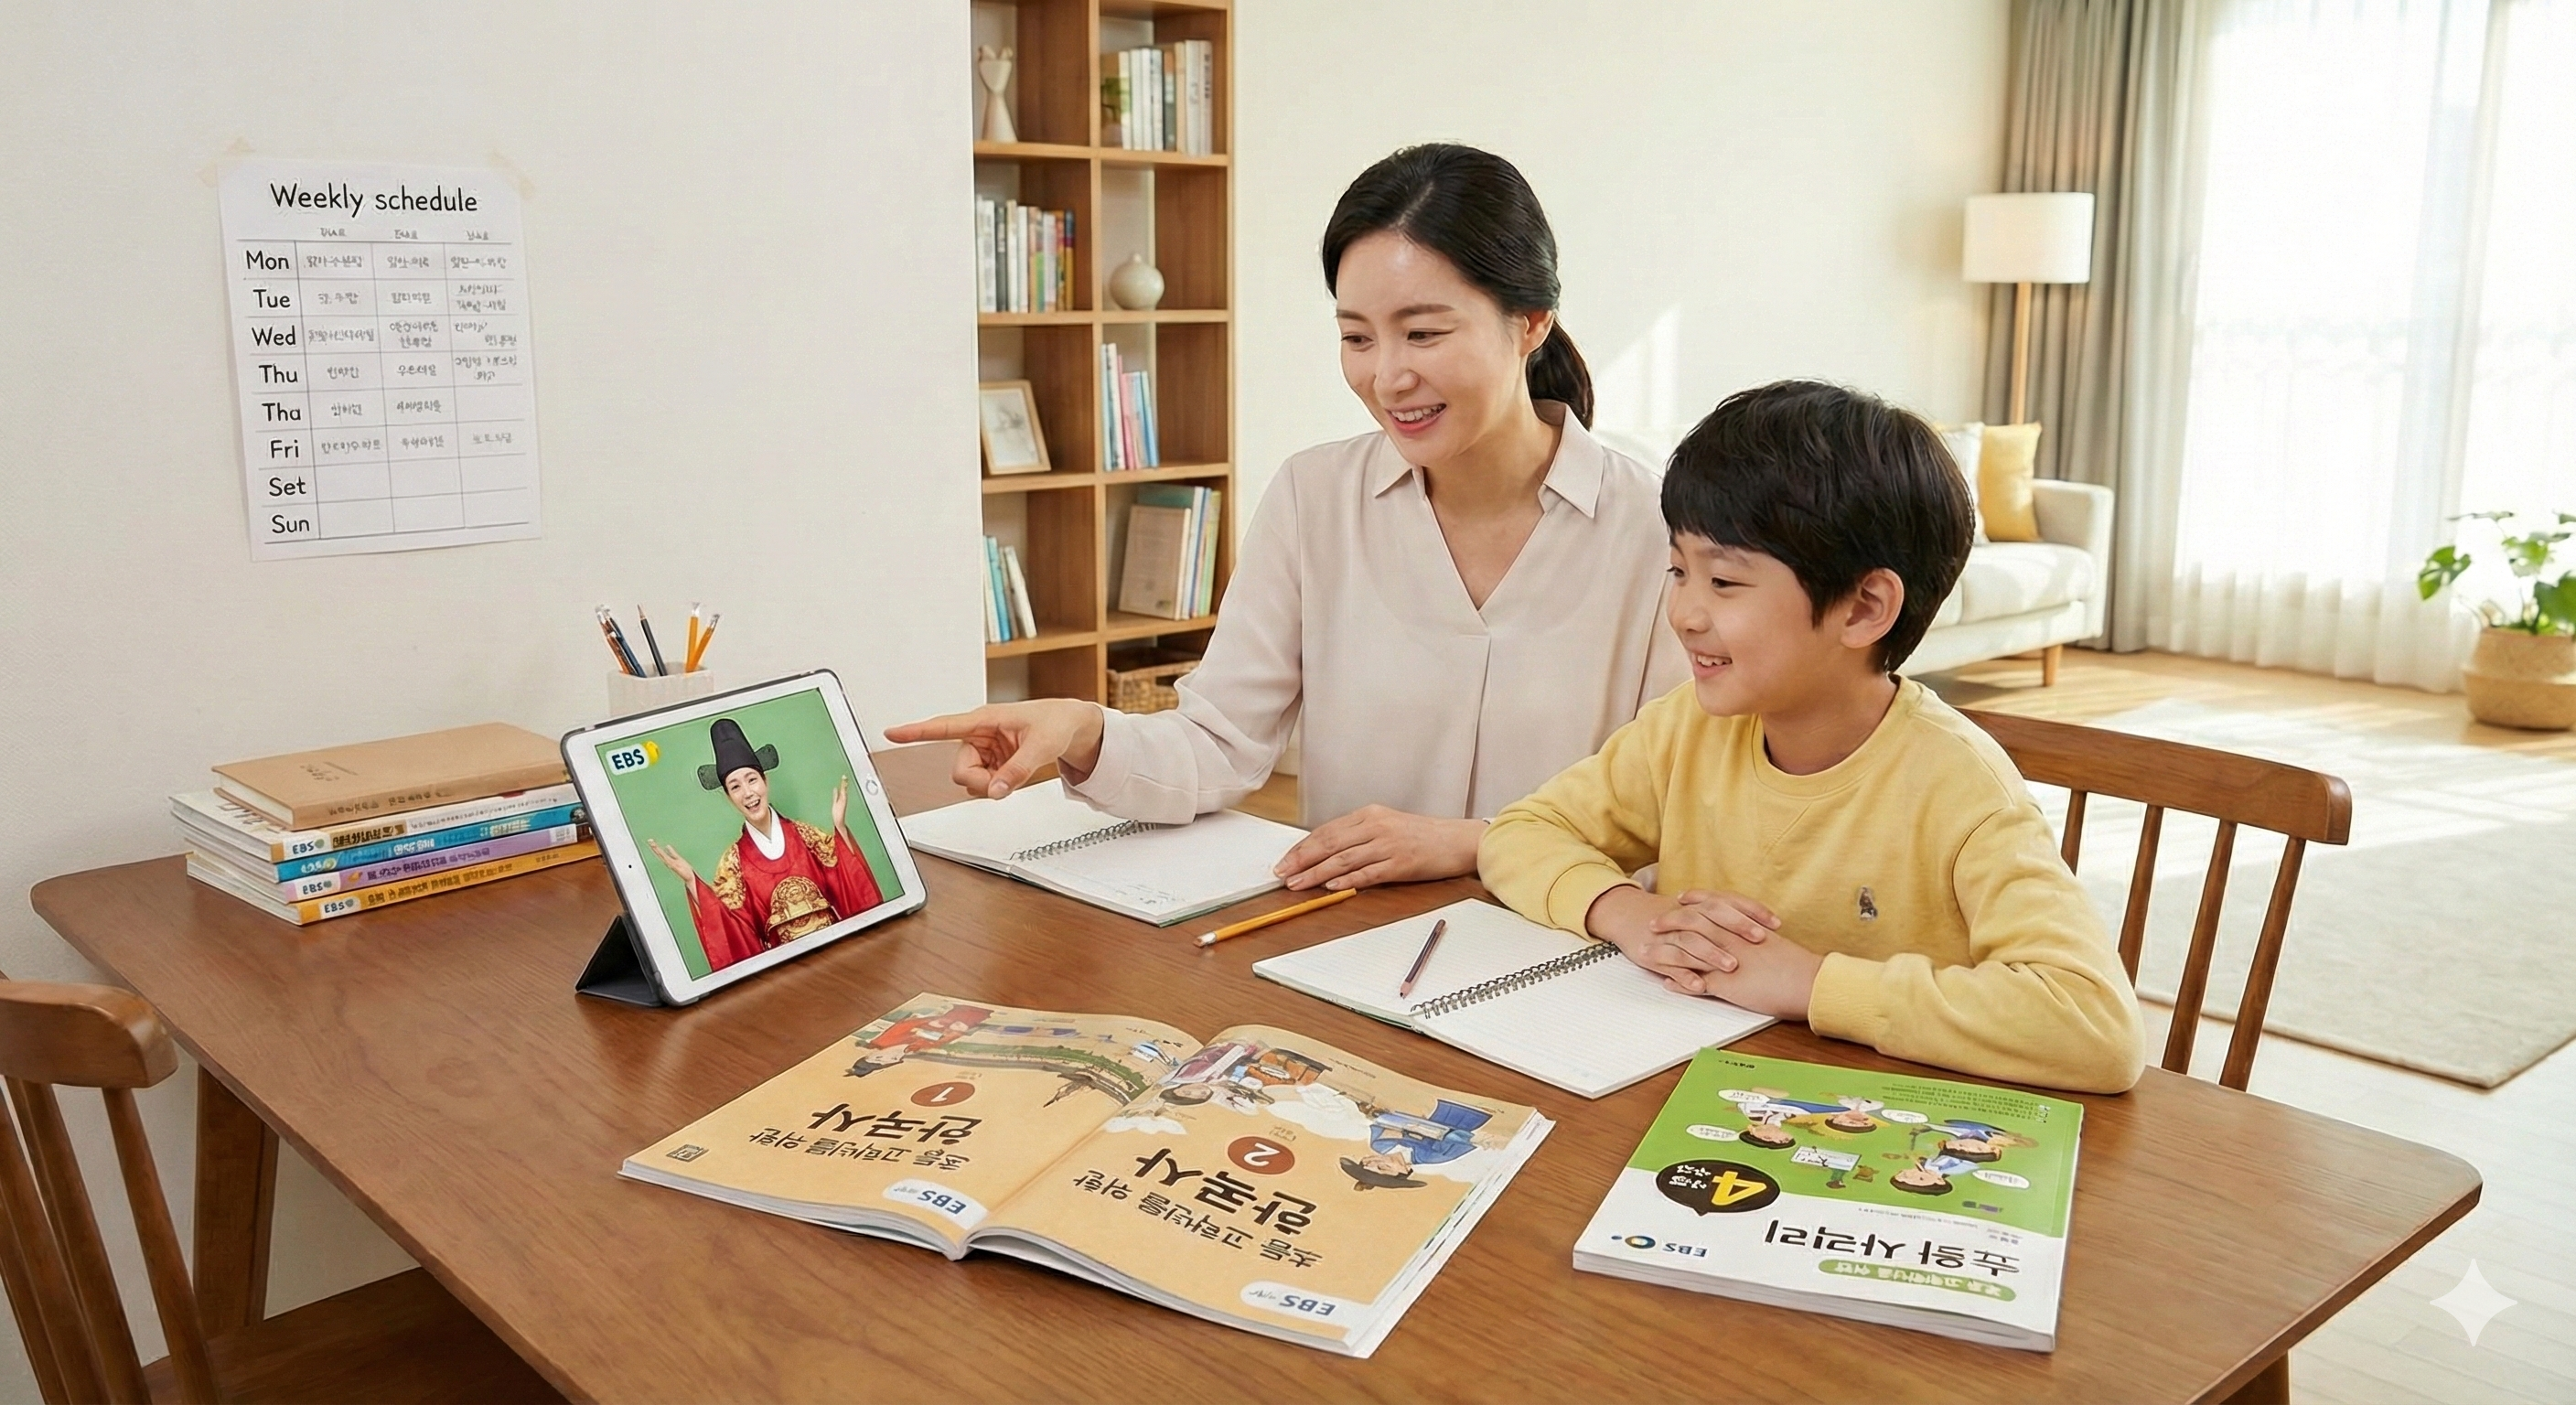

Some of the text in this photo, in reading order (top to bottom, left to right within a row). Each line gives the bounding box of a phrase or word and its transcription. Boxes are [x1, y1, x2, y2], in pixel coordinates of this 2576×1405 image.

[271, 182, 478, 218] Weekly schedule
[245, 250, 290, 271] Mon
[252, 288, 291, 308] Tue
[252, 327, 296, 347] Wed
[259, 363, 298, 383] Thu
[262, 402, 301, 422] Tha
[270, 440, 299, 459] Fri
[269, 477, 306, 497] Set
[272, 514, 310, 534] Sun
[611, 747, 646, 770] EBS
[929, 1087, 955, 1102] 1
[1243, 1142, 1280, 1166] 2
[1711, 1170, 1766, 1206] 4
[917, 1189, 966, 1215] EBS
[1661, 1240, 1708, 1258] EBS
[1279, 1294, 1336, 1316] EBS
